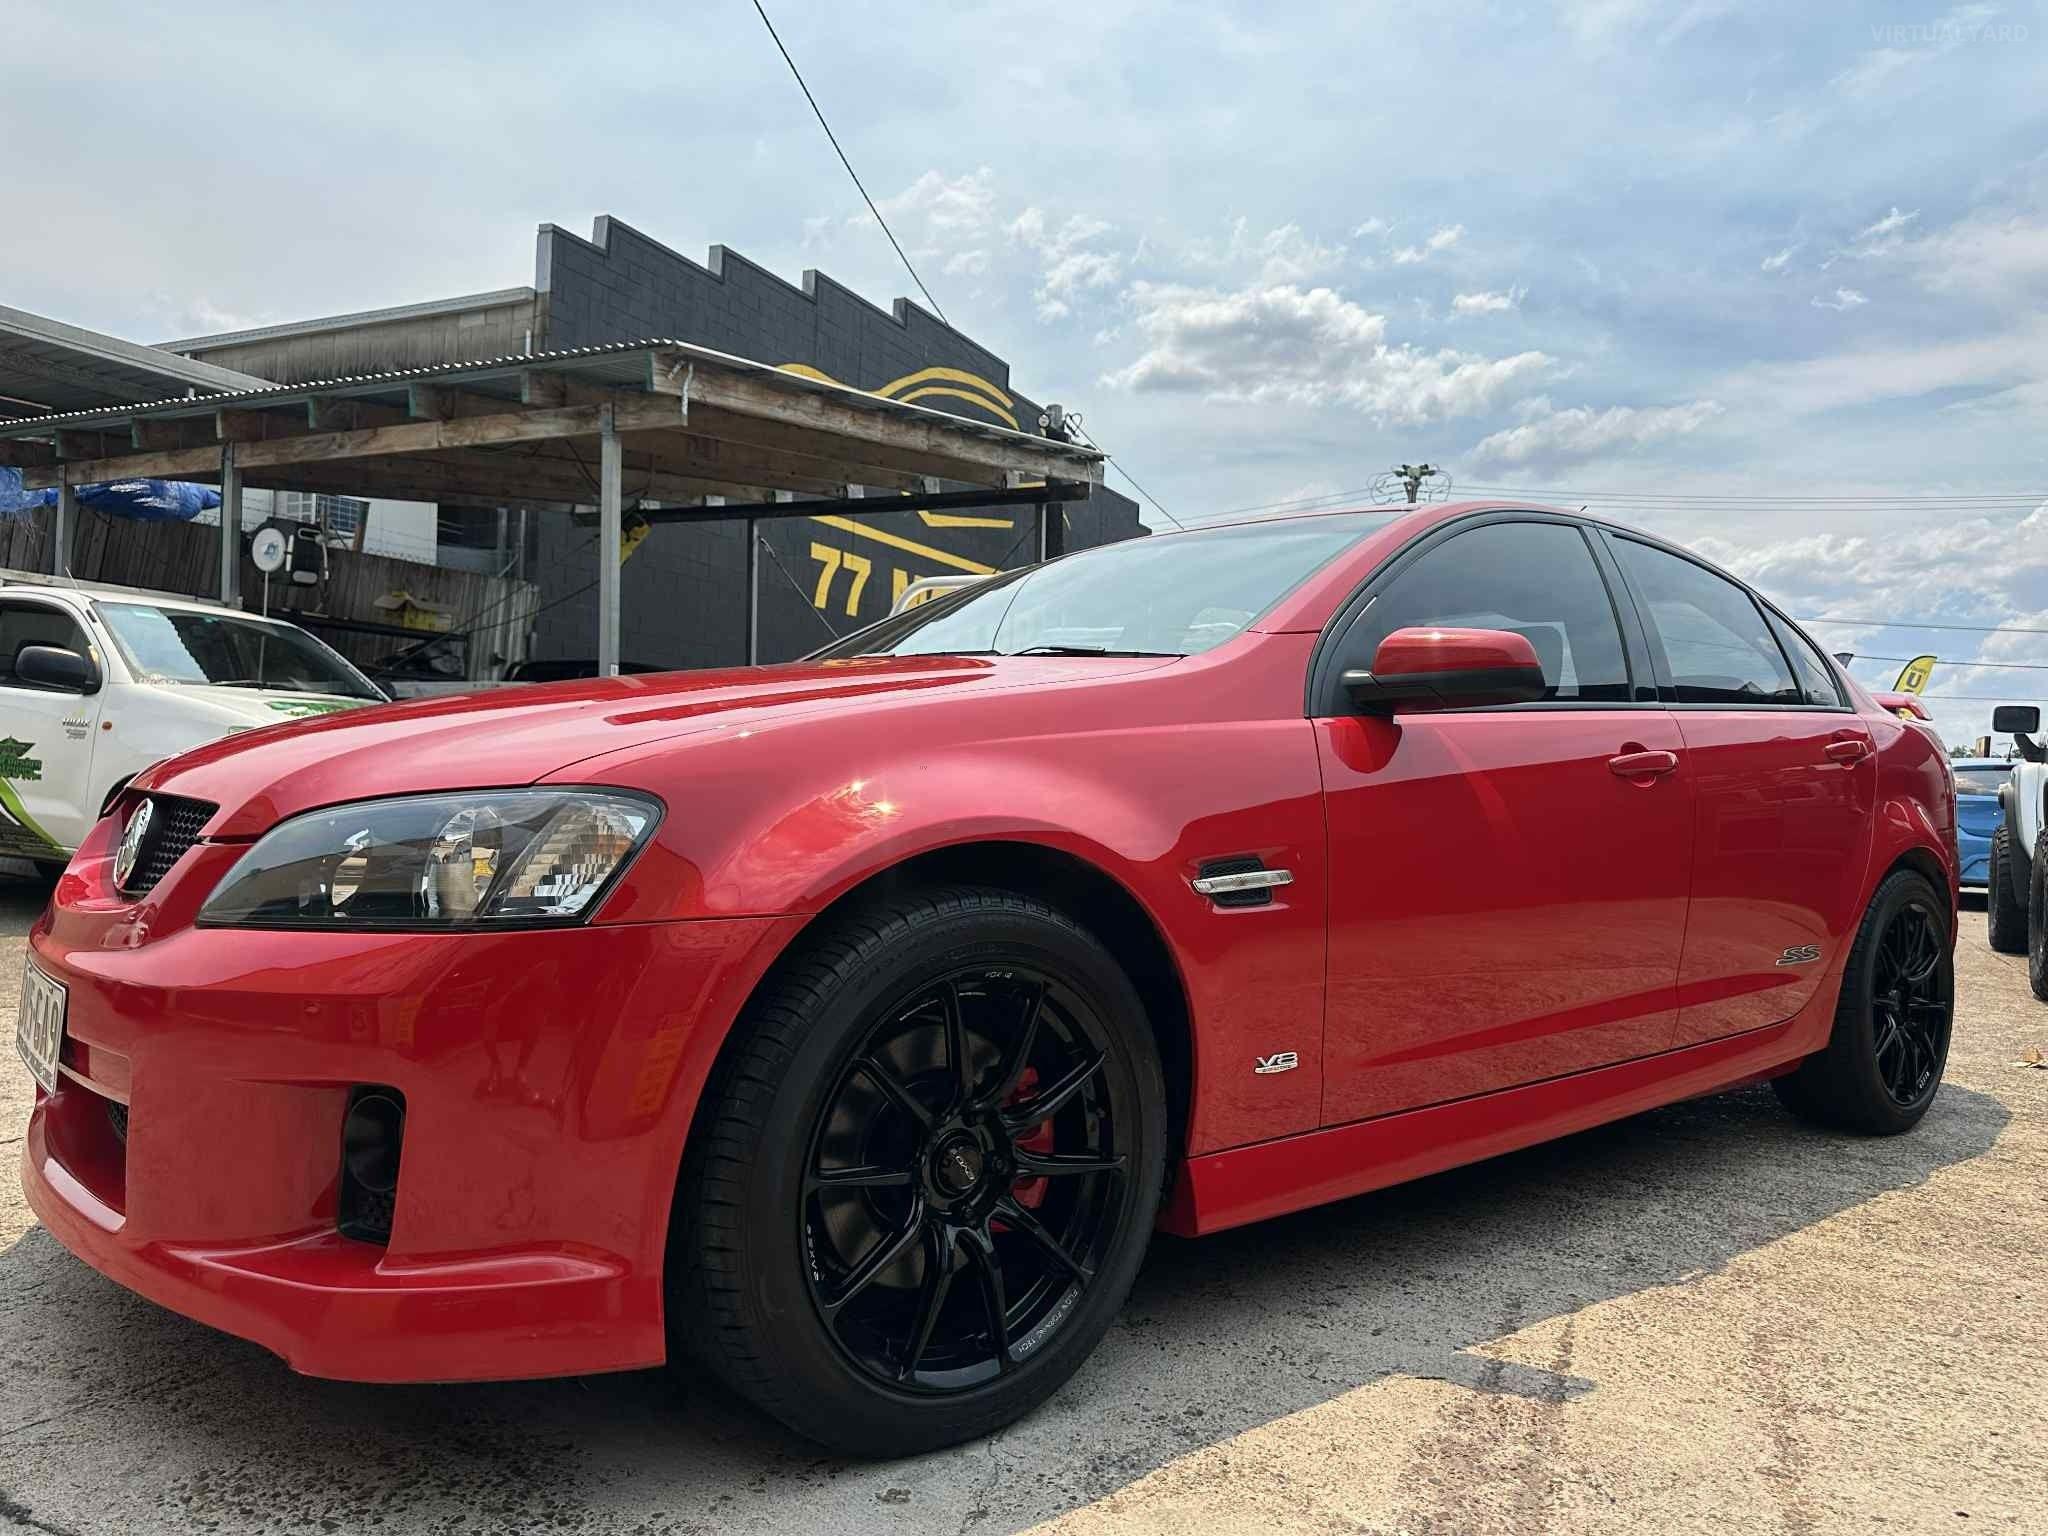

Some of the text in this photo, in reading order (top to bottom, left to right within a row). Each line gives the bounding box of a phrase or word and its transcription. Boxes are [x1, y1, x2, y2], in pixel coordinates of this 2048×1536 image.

[811, 542, 872, 617] 77
[1775, 944, 1822, 966] SS
[1254, 1051, 1298, 1069] V8
